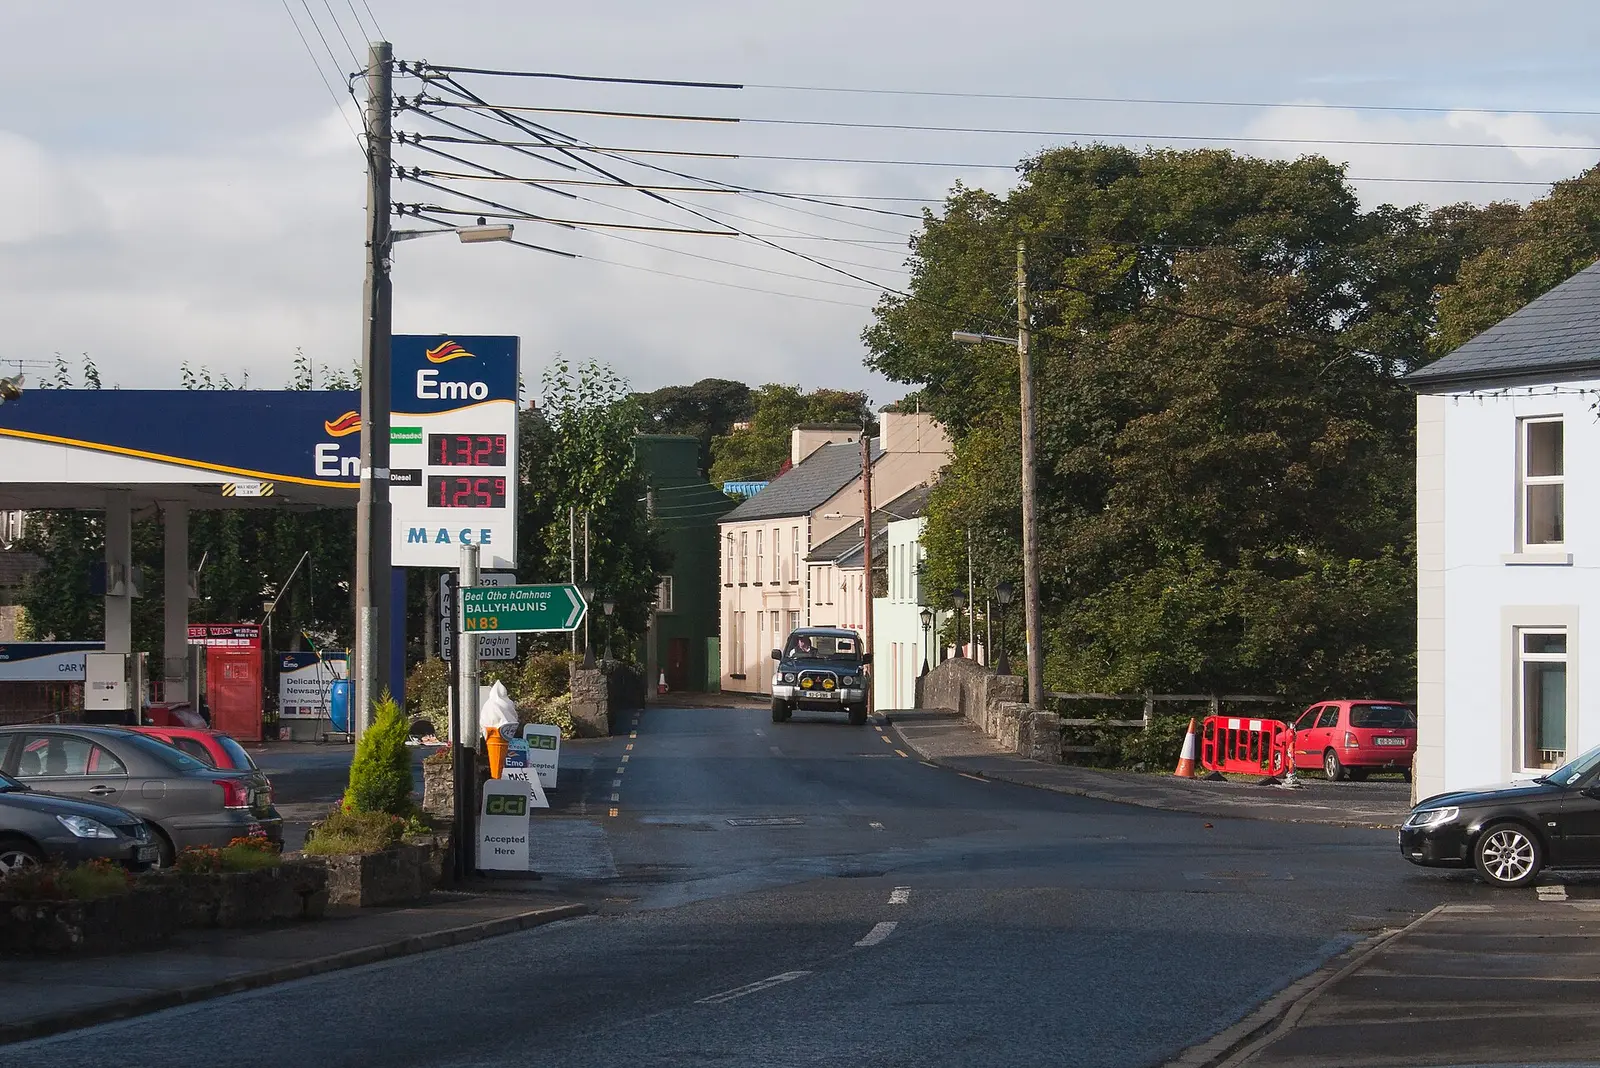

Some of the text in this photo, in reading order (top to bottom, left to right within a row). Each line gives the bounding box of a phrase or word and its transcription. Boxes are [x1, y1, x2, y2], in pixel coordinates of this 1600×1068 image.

[416, 369, 489, 400] Emo
[390, 432, 422, 440] Unleaded
[315, 443, 361, 477] Em
[390, 474, 412, 482] Diesel
[407, 528, 492, 544] MACE
[466, 602, 547, 613] BALLYHAUNIS
[188, 627, 207, 637] EED
[58, 663, 77, 672] CAR
[528, 735, 556, 750] dci
[505, 757, 524, 767] Emo
[508, 772, 530, 781] MACE
[489, 797, 524, 816] dci
[484, 835, 525, 844] Accepted
[494, 848, 516, 856] Here
